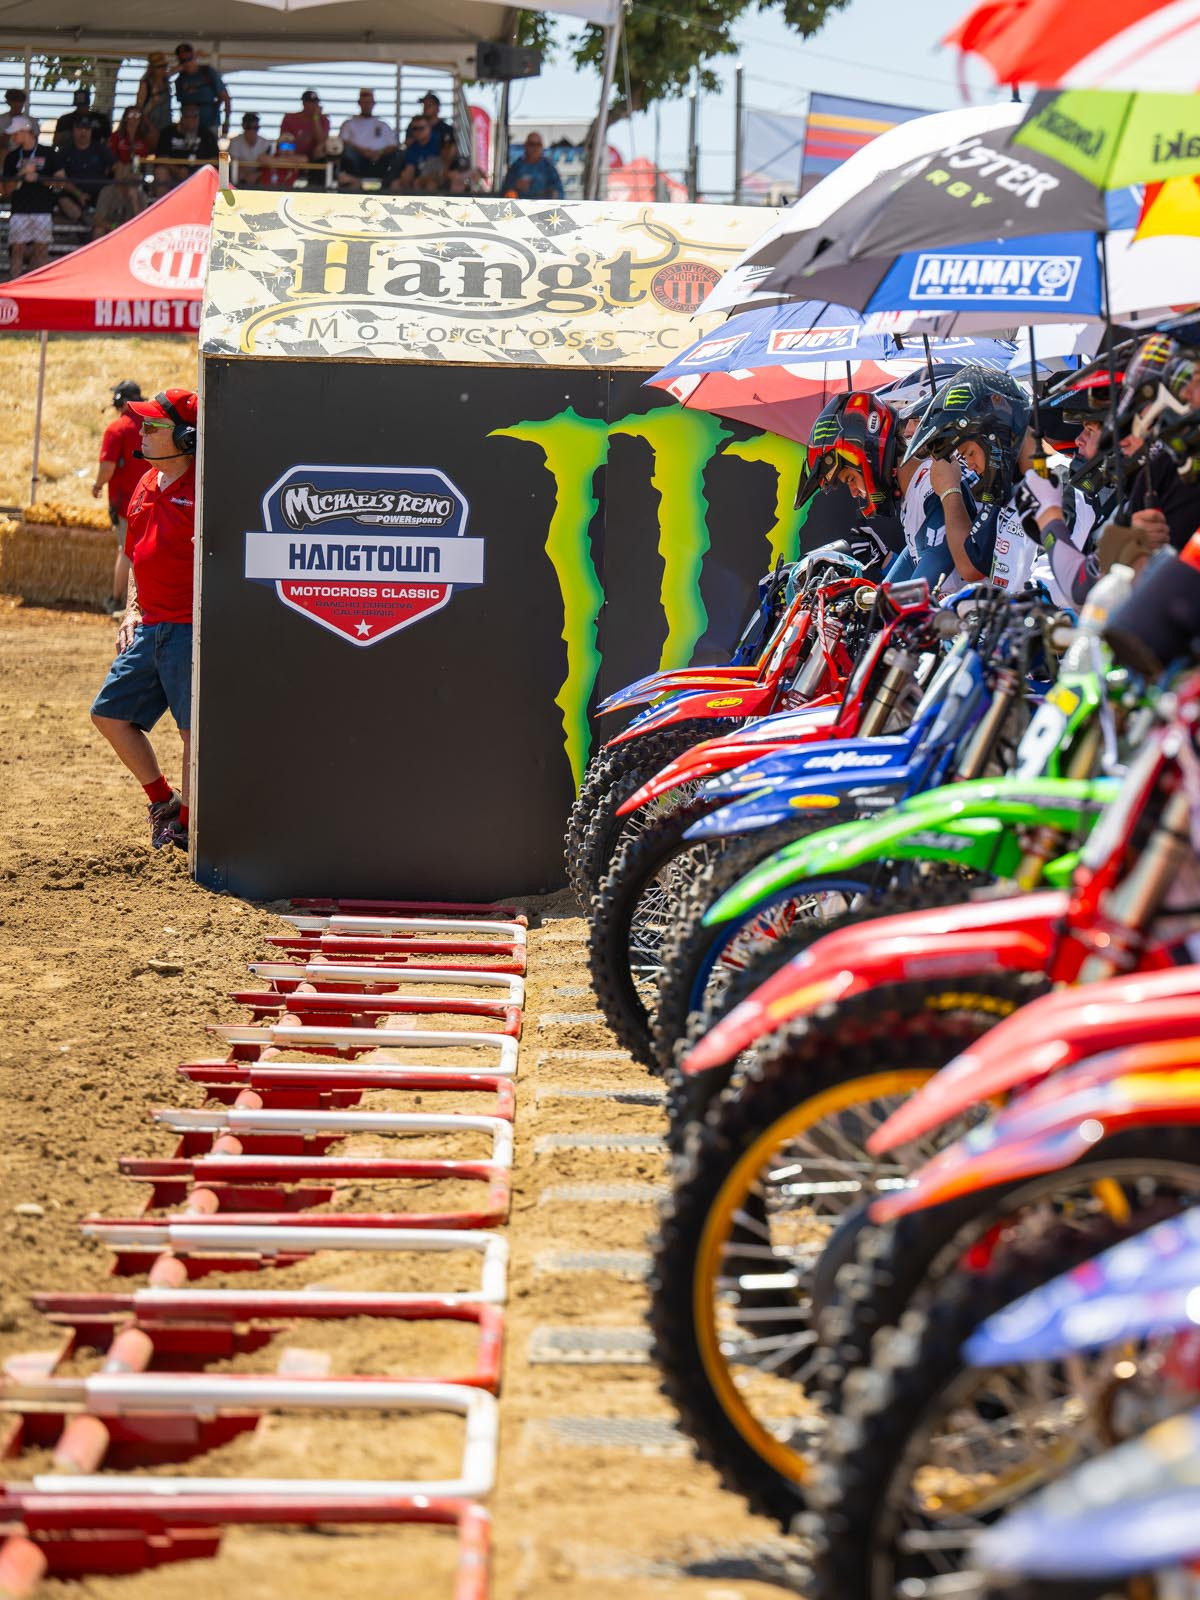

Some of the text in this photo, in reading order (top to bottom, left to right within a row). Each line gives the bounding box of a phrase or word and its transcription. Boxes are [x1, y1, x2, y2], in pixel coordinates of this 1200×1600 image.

[673, 271, 705, 282] NORTH
[307, 317, 616, 349] Motocross
[776, 328, 850, 350] 100%
[396, 494, 451, 516] RENO
[288, 543, 441, 573] HANGTOWN
[289, 586, 440, 600] MOTOCROSS CLASSIC
